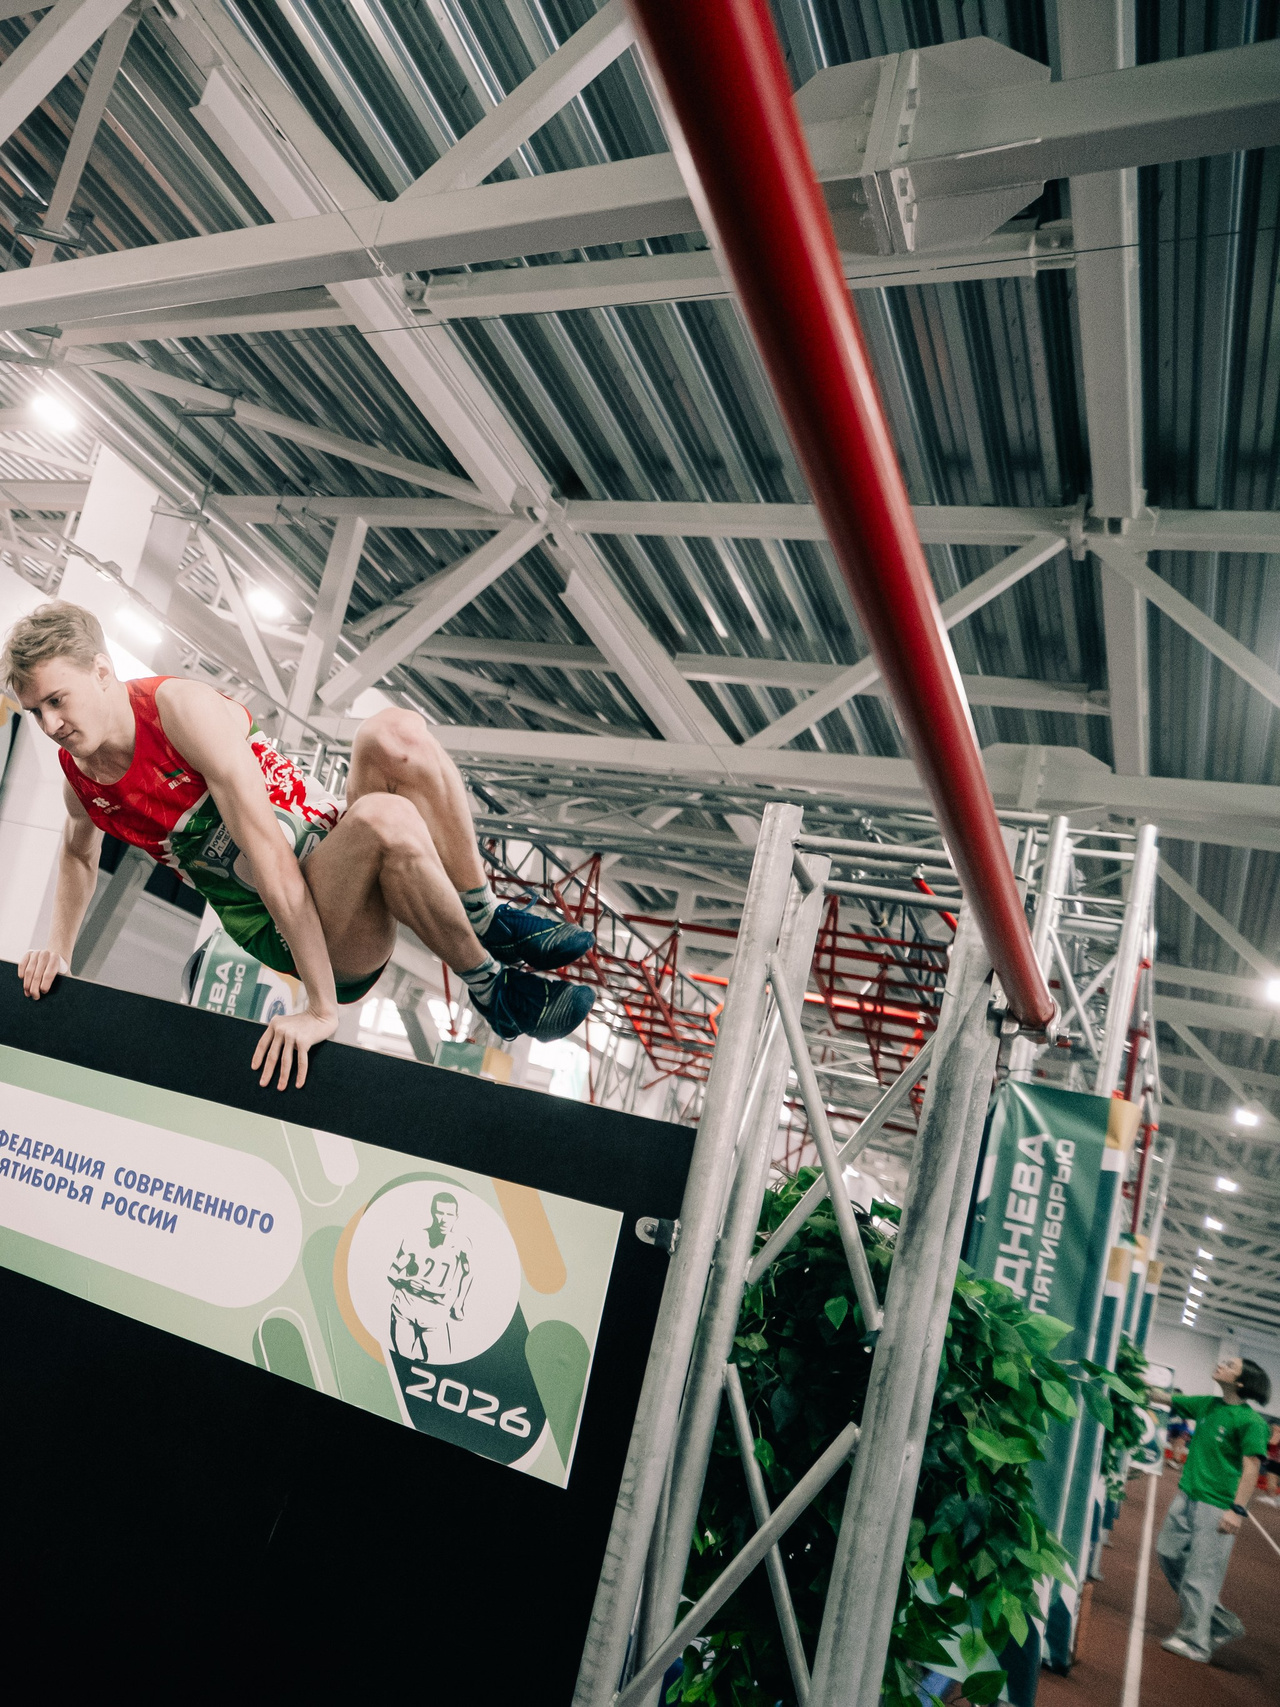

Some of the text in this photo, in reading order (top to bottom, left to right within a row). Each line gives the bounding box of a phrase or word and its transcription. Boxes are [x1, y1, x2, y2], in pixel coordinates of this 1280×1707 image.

[101, 1191, 178, 1234] РОССИИ
[113, 1166, 275, 1234] СОВРЕМЕННОГО
[1028, 1138, 1076, 1315] ПЯТИБОРЬЮ
[420, 1257, 450, 1287] 27
[405, 1365, 532, 1438] 2026
